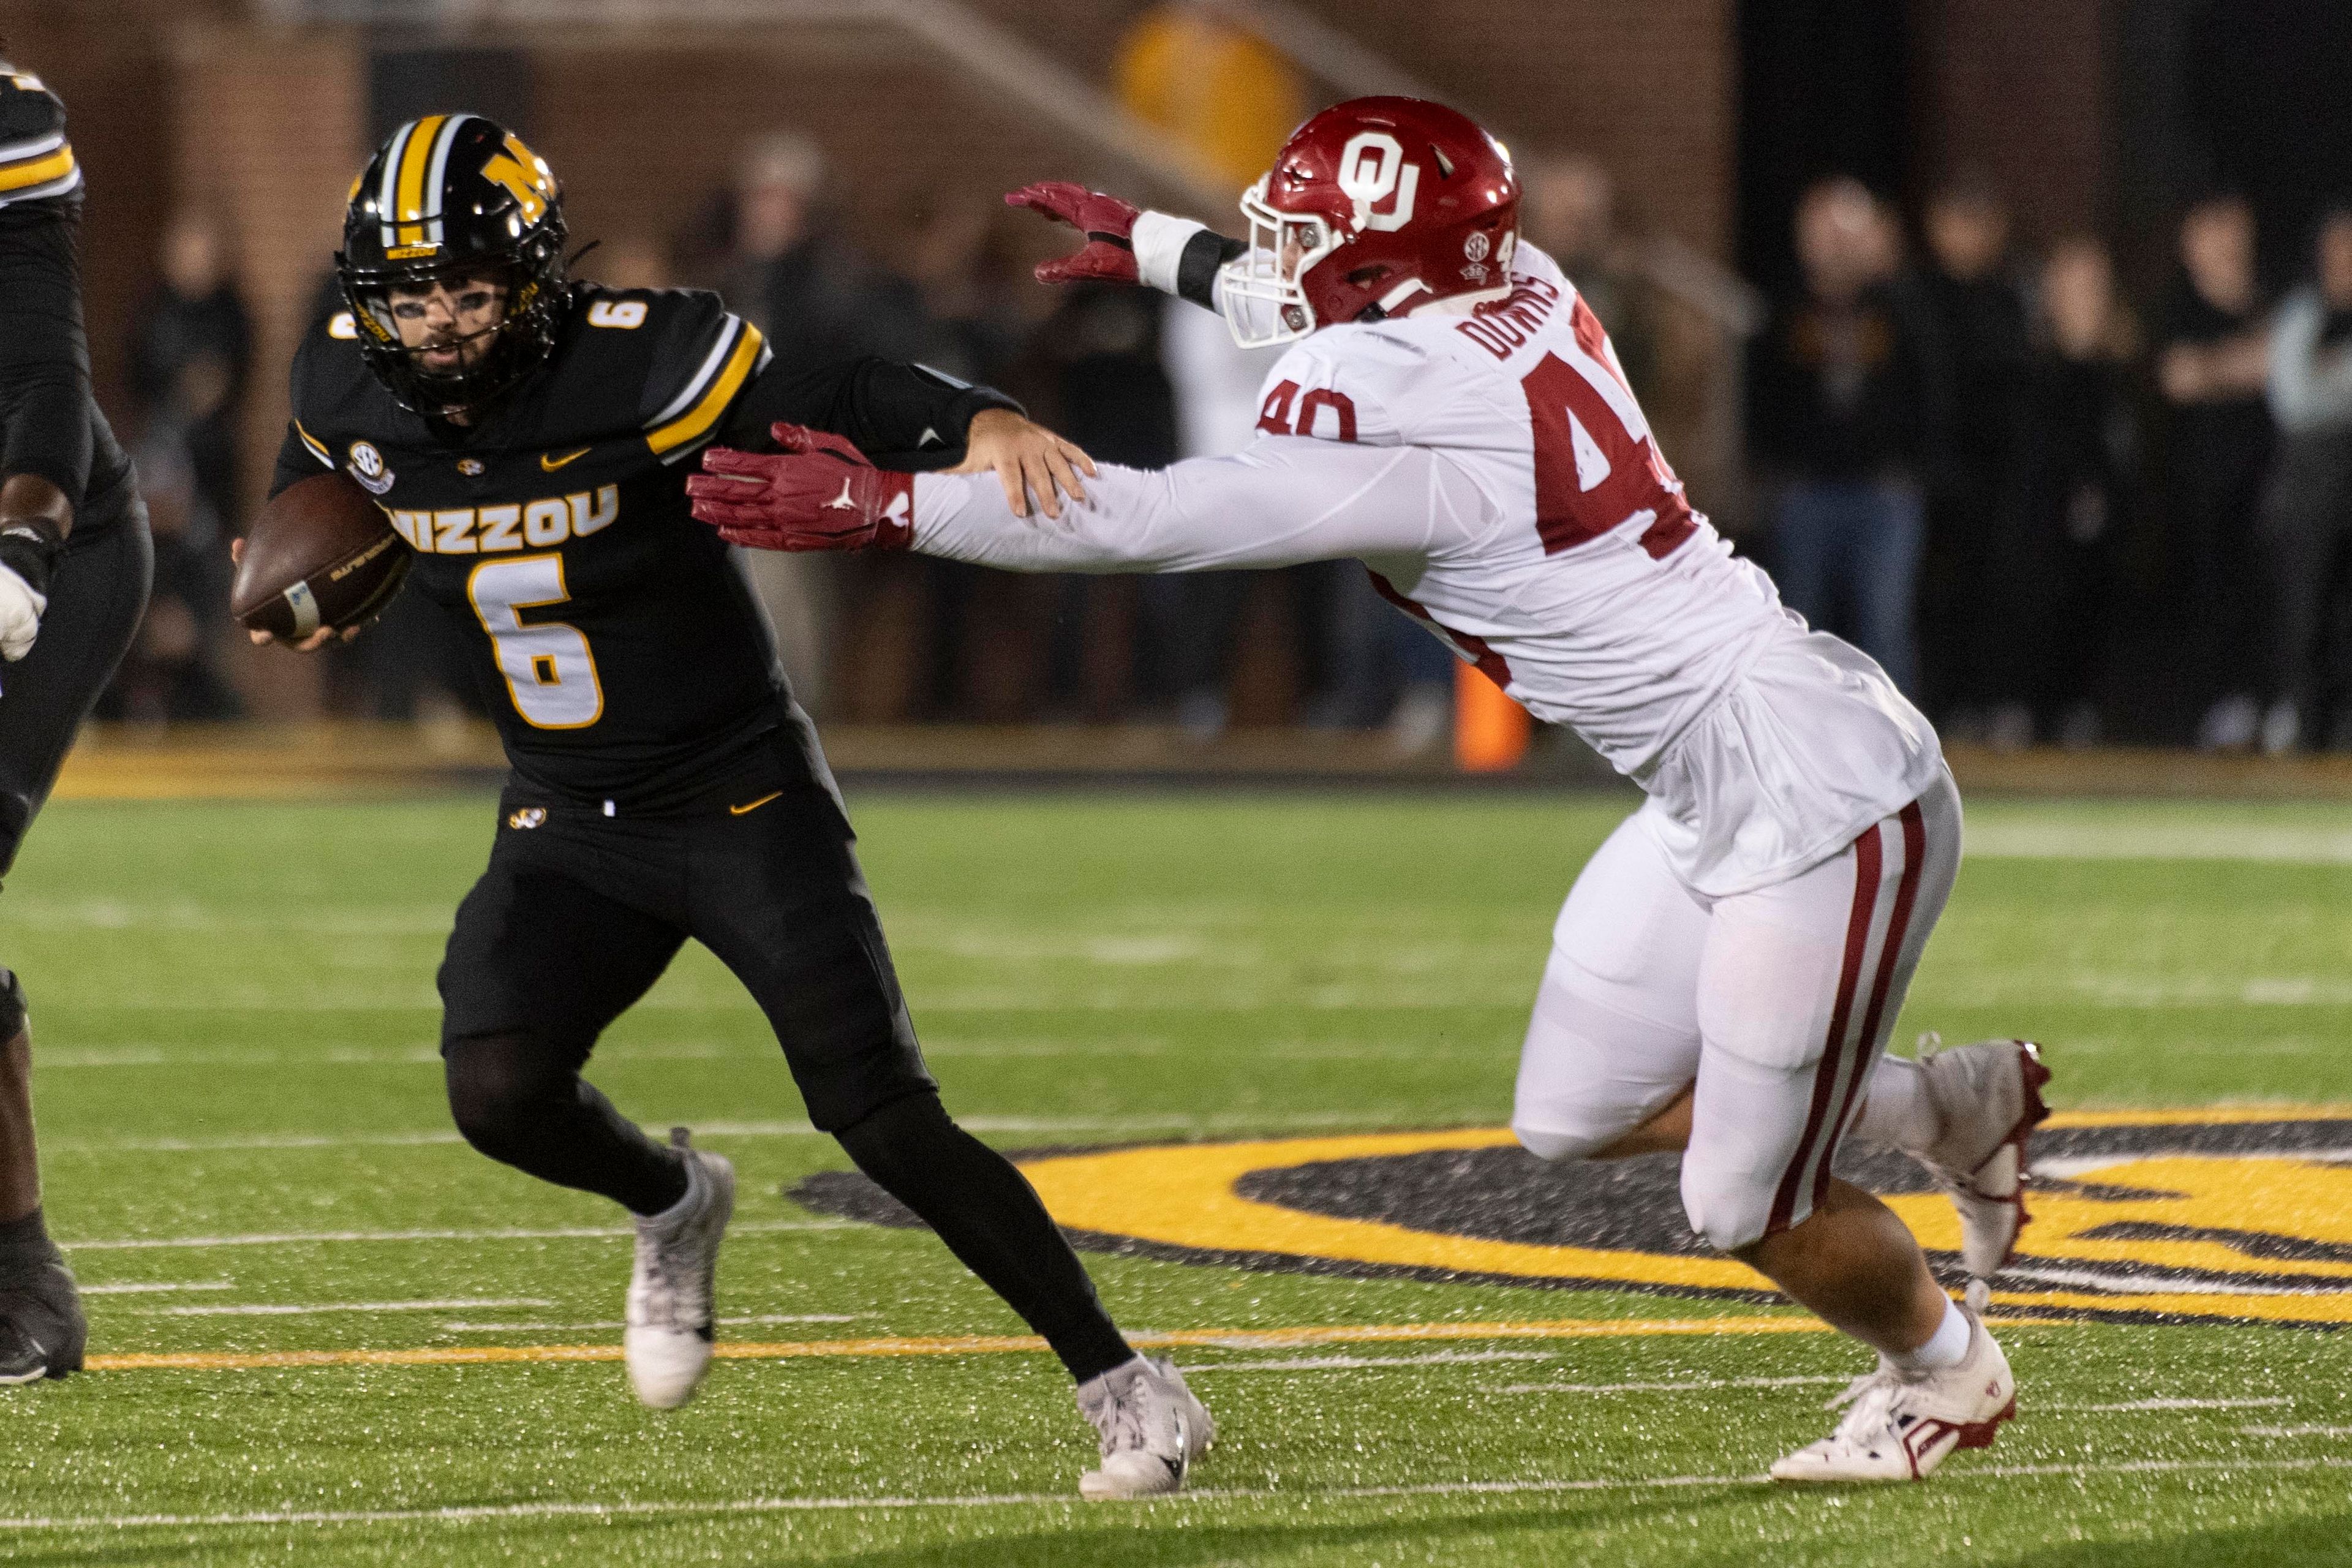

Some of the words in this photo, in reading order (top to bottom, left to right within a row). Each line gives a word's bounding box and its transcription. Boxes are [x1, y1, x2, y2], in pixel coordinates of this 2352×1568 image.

[481, 132, 556, 227] M
[1337, 132, 1420, 233] OU
[587, 300, 649, 330] 6
[1255, 379, 1359, 442] 40
[351, 443, 382, 476] SEC
[466, 551, 605, 729] 6
